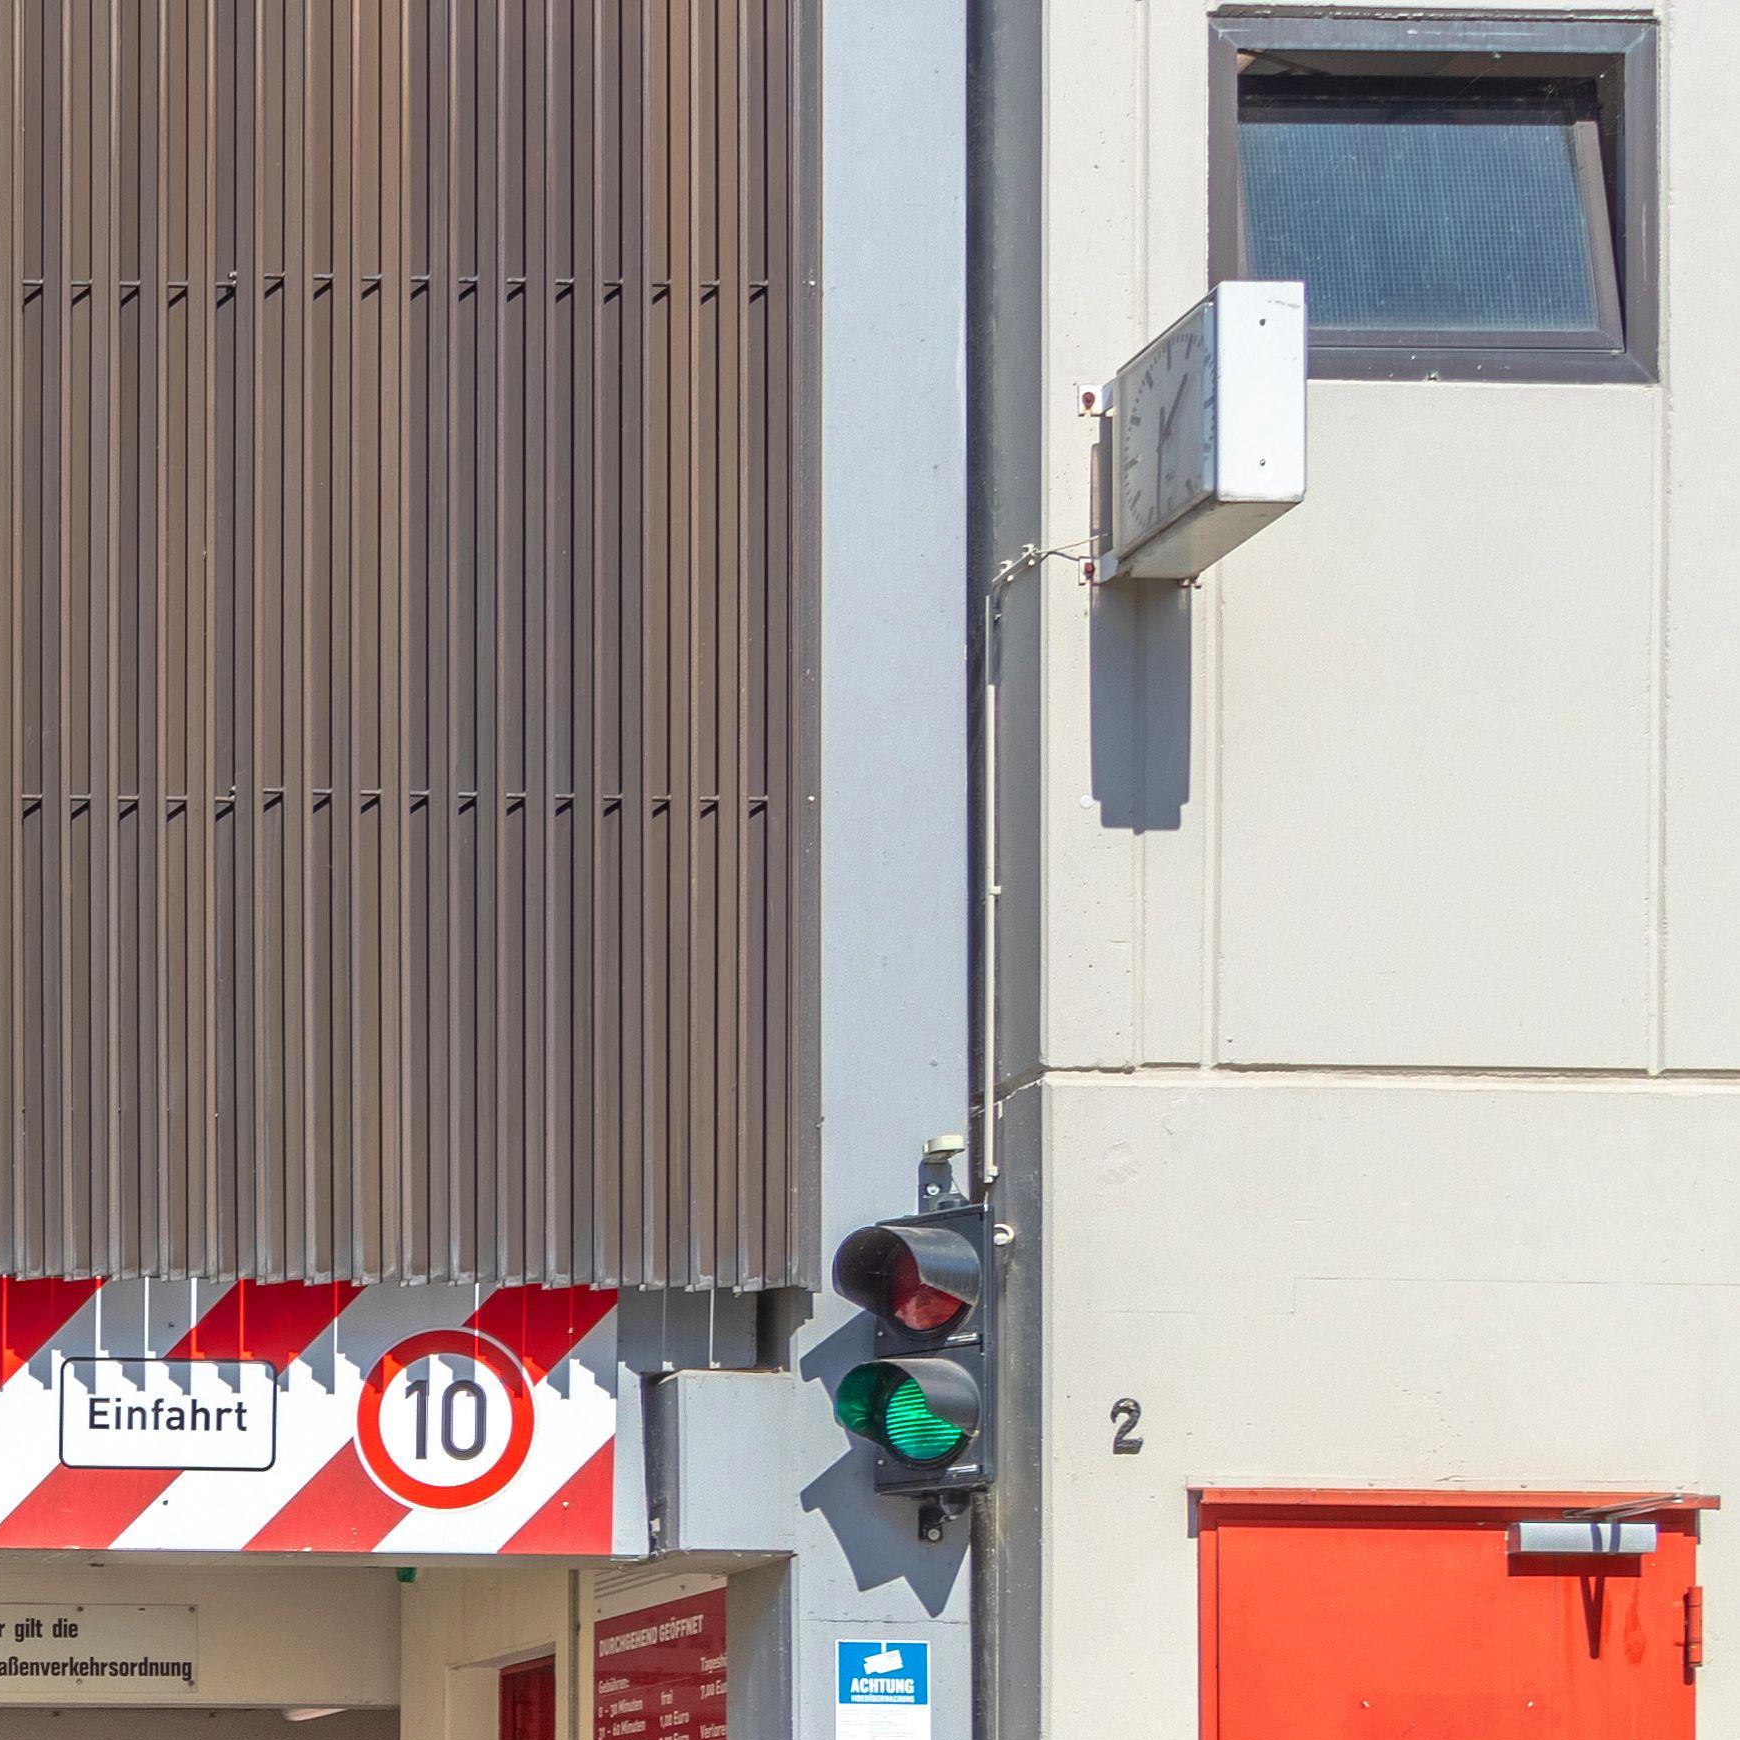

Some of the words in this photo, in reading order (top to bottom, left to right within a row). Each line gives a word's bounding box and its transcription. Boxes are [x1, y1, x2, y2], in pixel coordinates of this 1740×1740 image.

[88, 1398, 248, 1433] Einfahrt
[406, 1379, 488, 1461] 10
[1110, 1398, 1144, 1454] 2
[14, 1618, 43, 1643] gilt
[52, 1618, 78, 1639] die
[850, 1678, 915, 1694] ACHTUNG
